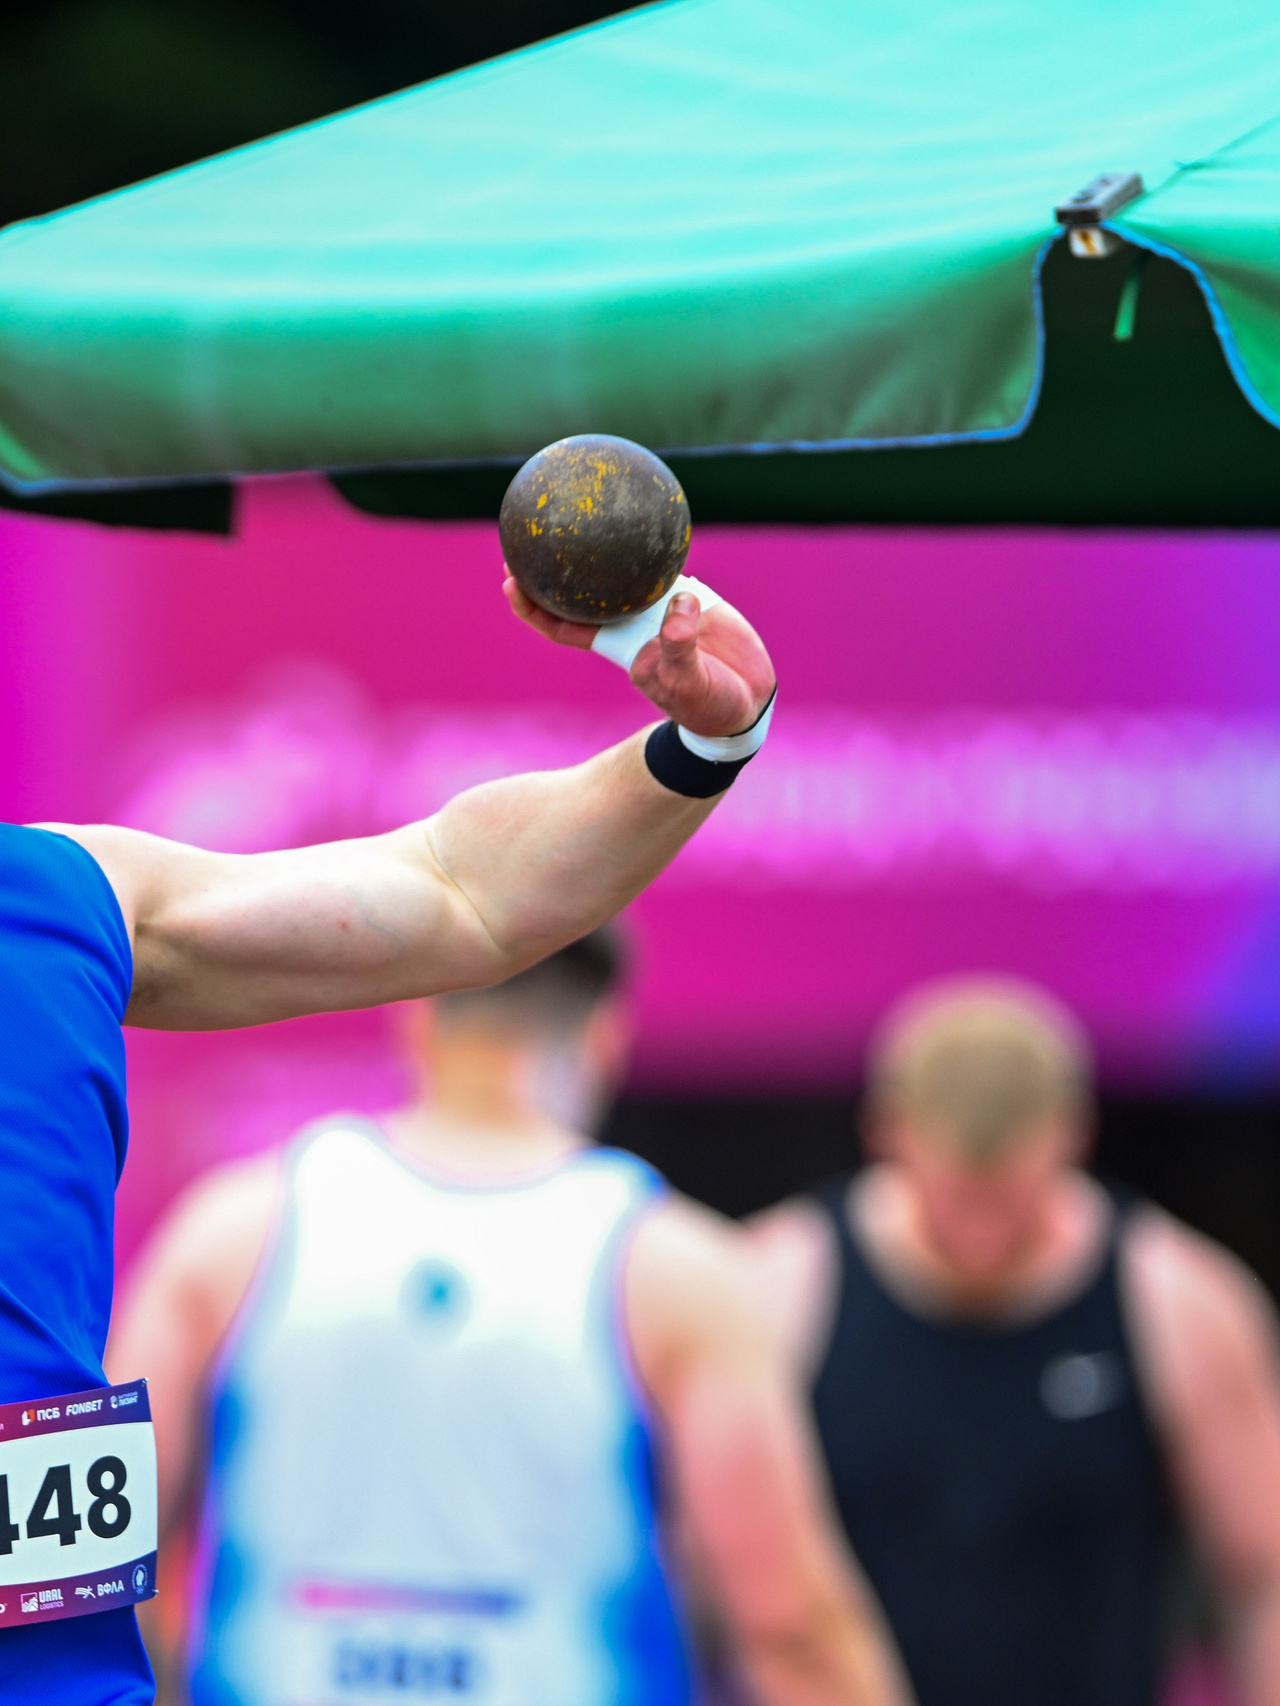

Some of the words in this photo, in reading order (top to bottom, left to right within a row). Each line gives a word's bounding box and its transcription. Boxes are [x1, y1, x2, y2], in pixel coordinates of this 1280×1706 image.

[37, 1407, 60, 1421] ПСБ
[65, 1399, 103, 1416] FONBET
[39, 1588, 64, 1603] URAL
[97, 1580, 125, 1597] ВФЛА
